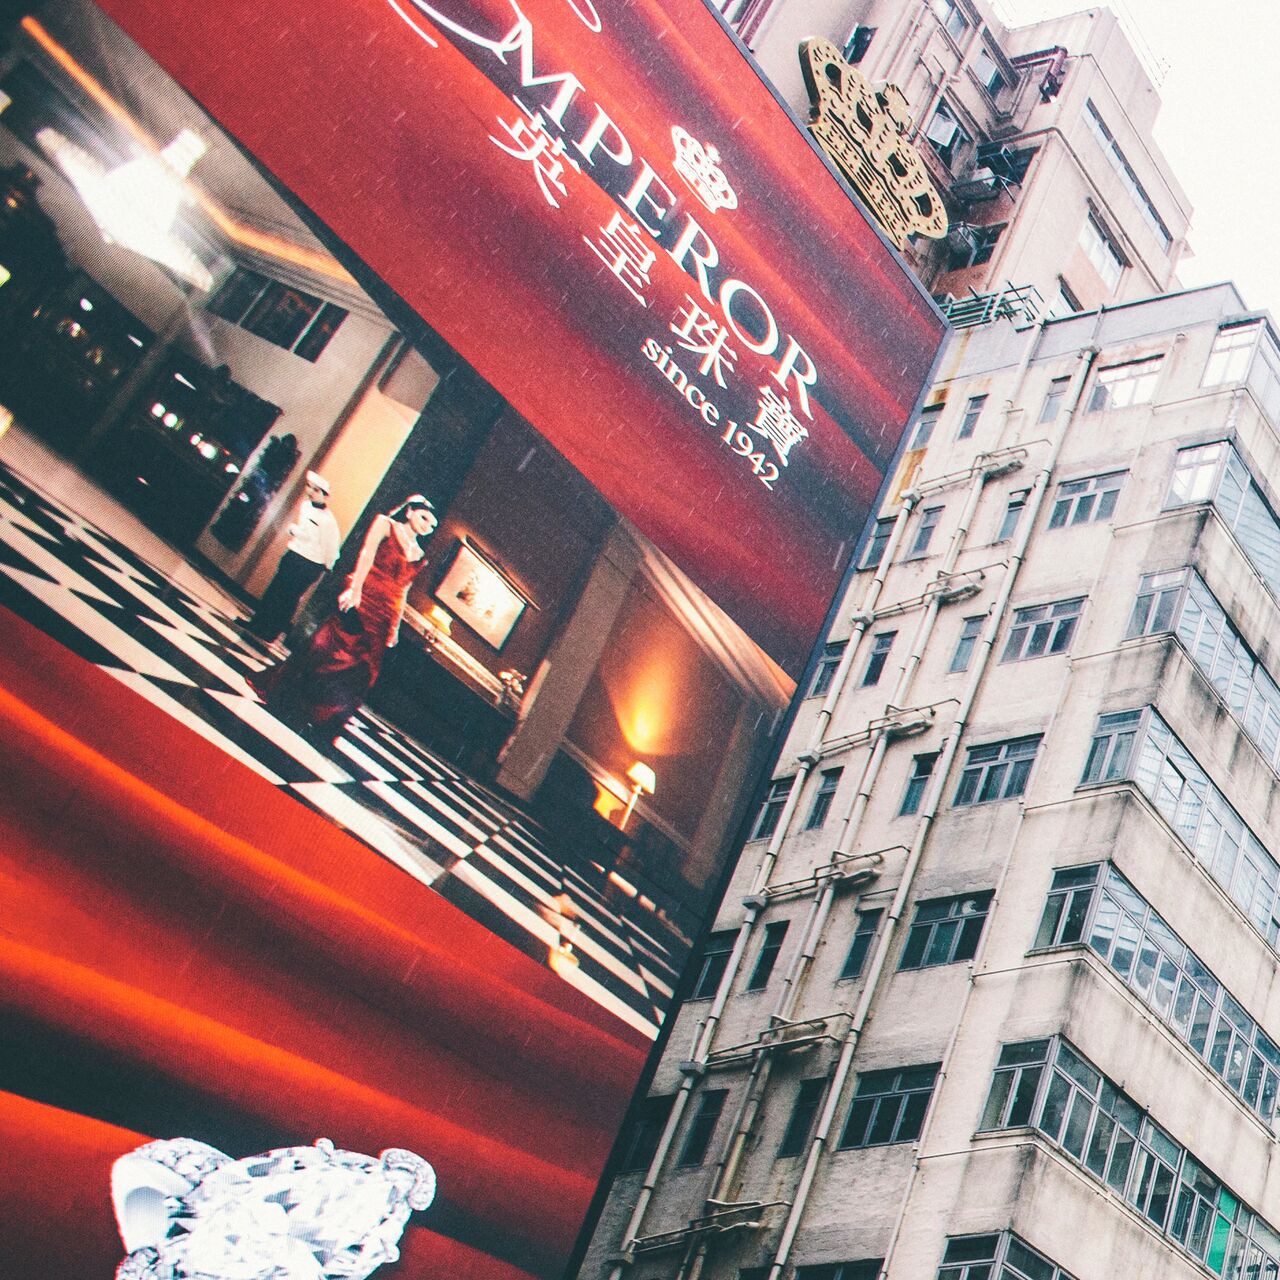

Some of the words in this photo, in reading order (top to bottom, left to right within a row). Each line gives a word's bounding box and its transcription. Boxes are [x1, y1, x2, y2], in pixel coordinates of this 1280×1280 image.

[488, 95, 810, 468] 英皇珠寶
[640, 336, 720, 427] since
[721, 413, 783, 491] 1942
